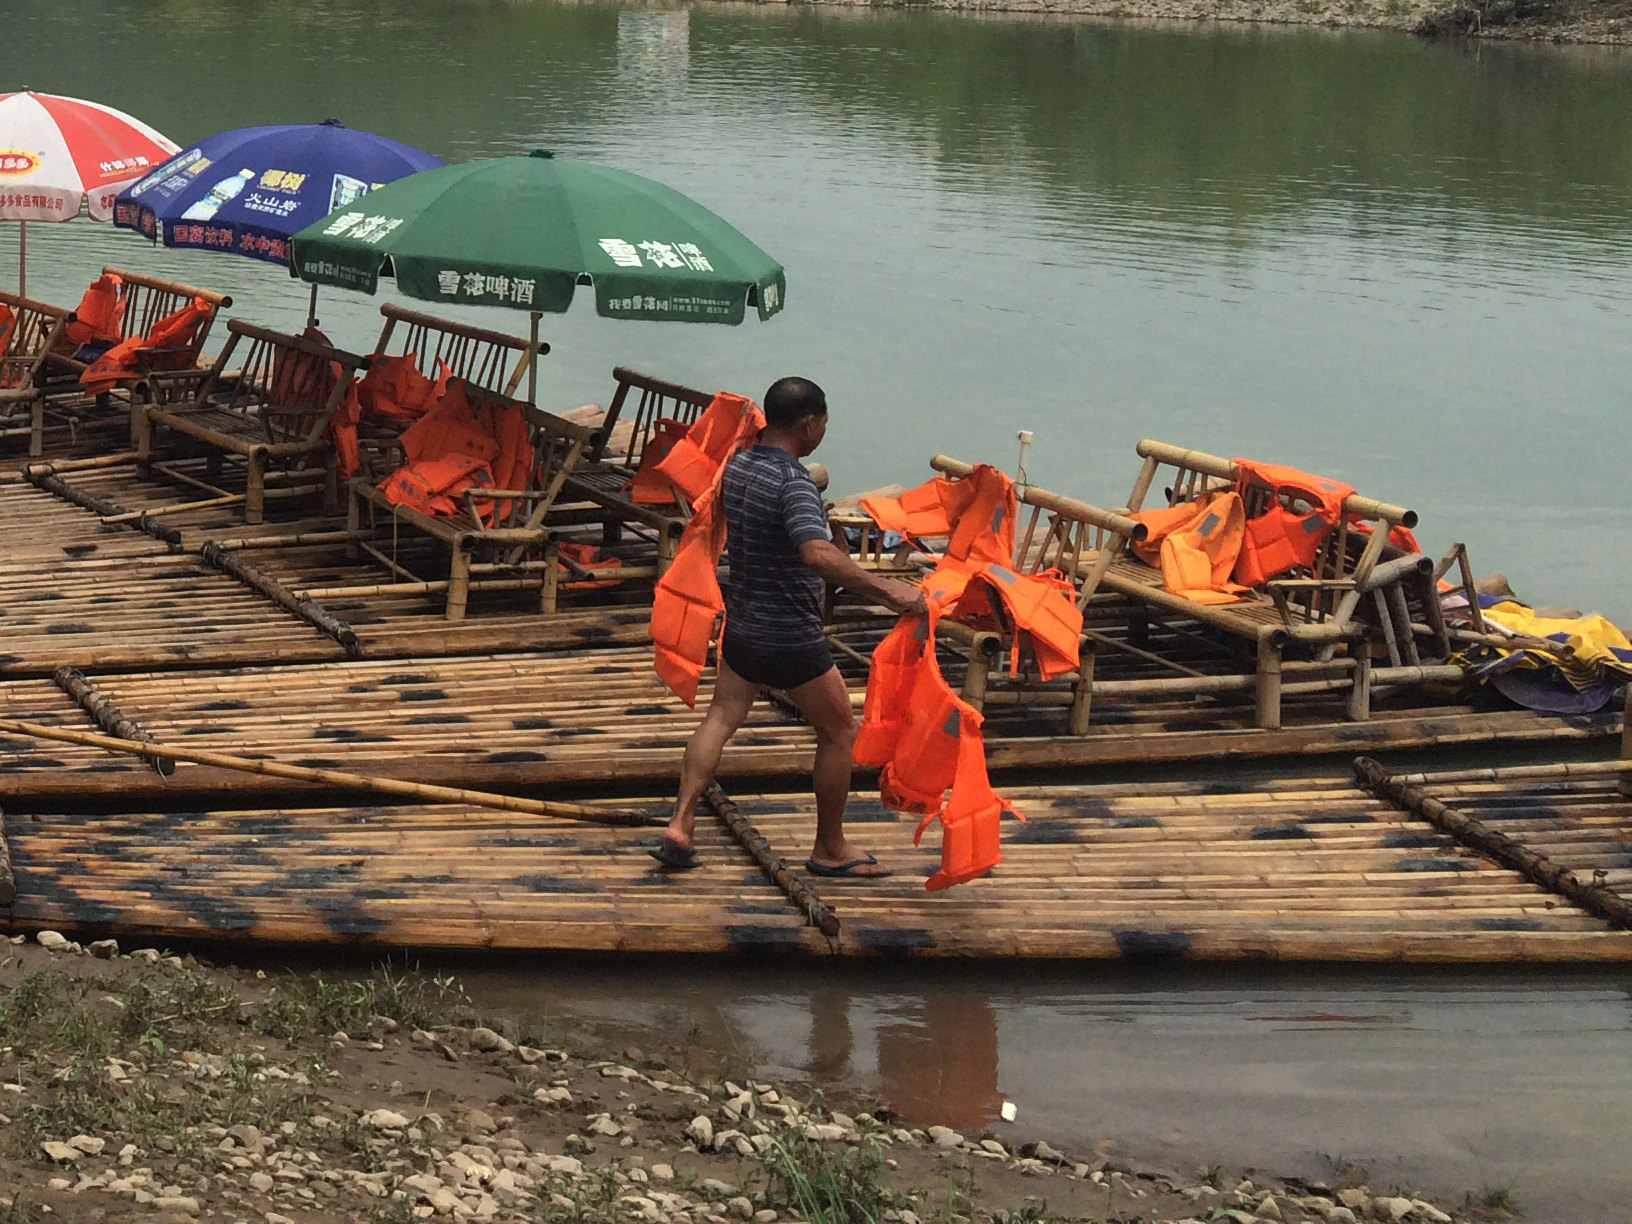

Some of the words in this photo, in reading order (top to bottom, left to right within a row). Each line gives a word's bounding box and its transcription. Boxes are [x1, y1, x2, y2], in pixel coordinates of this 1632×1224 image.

[244, 193, 297, 212] 火山岩
[173, 224, 234, 247] 国宴饮料
[598, 238, 686, 268] 雪花
[437, 270, 536, 305] 雪花啤酒
[608, 295, 668, 312] 我要雪花网
